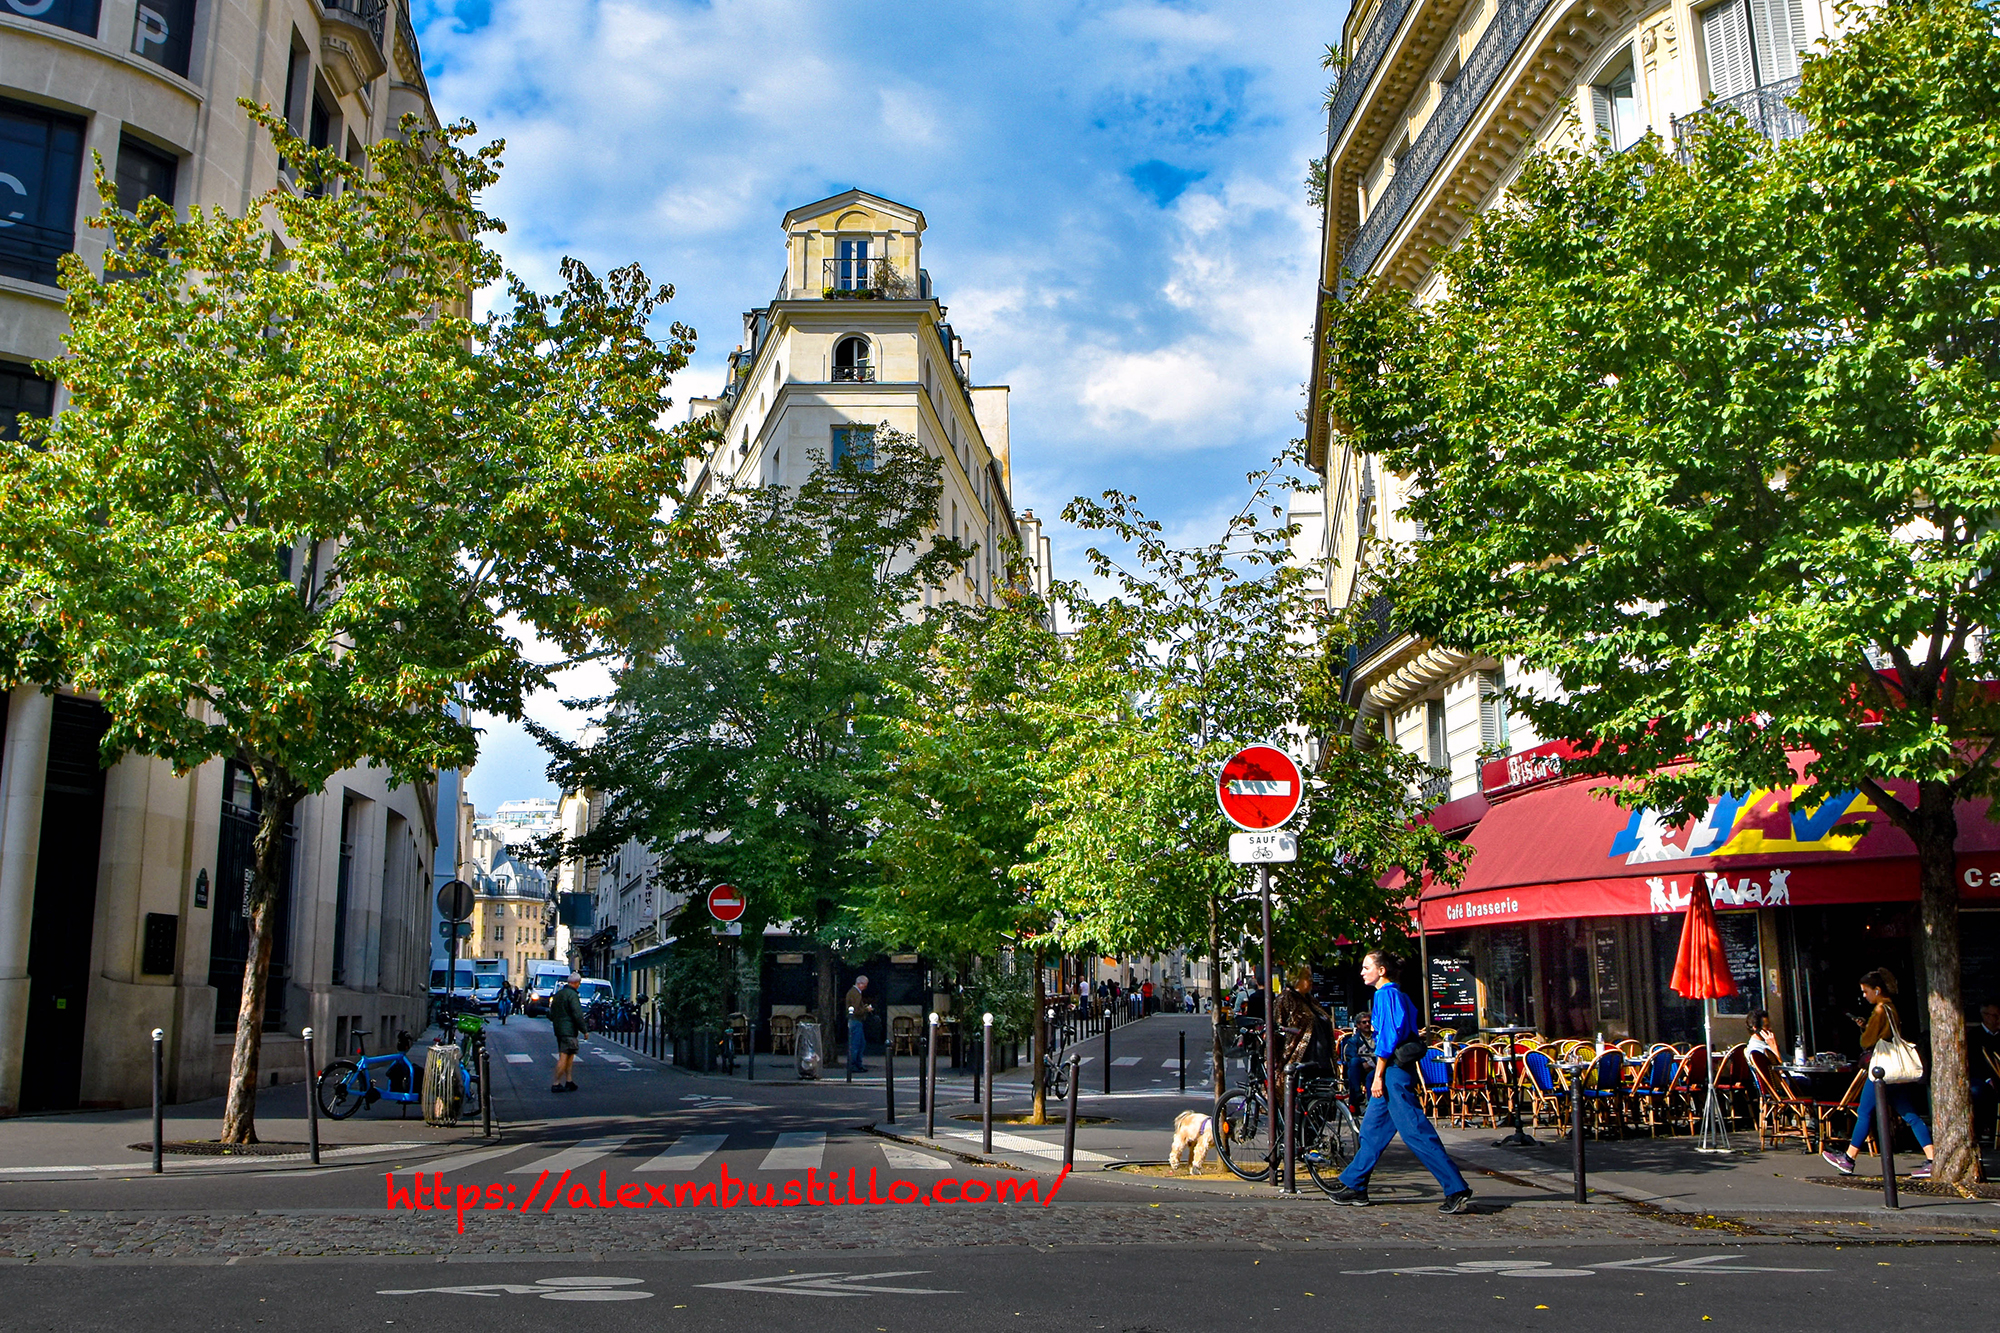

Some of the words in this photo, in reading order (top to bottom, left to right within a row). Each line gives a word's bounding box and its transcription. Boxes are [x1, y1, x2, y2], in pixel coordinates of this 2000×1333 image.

[1249, 836, 1276, 844] SAUF
[1447, 904, 1464, 920] Café
[1466, 897, 1518, 918] Brasserie
